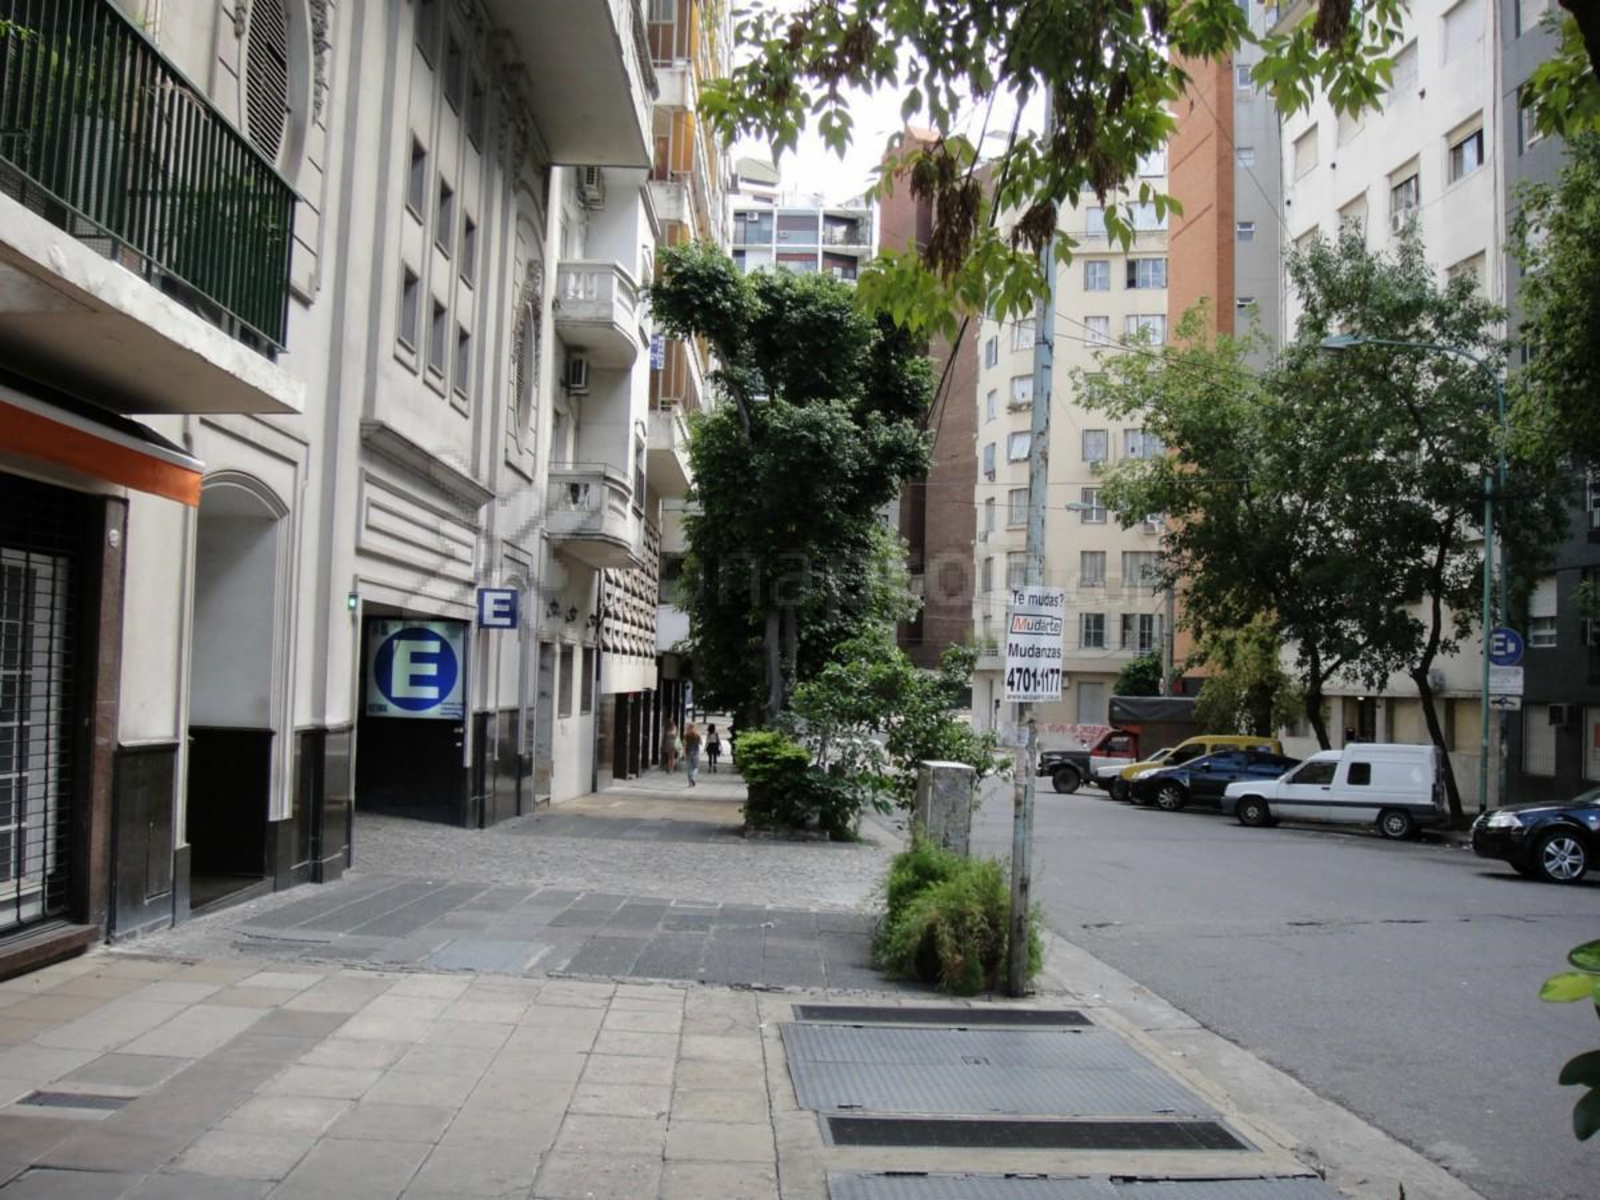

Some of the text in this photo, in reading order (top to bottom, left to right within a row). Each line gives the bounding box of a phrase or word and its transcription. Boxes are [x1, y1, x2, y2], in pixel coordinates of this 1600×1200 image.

[483, 591, 511, 626] E
[1012, 590, 1025, 605] Te
[1014, 617, 1060, 632] Mudarte
[1008, 643, 1061, 658] Mudanzas
[1490, 633, 1506, 656] E
[391, 639, 440, 699] E
[1007, 667, 1060, 692] 4701-1177
